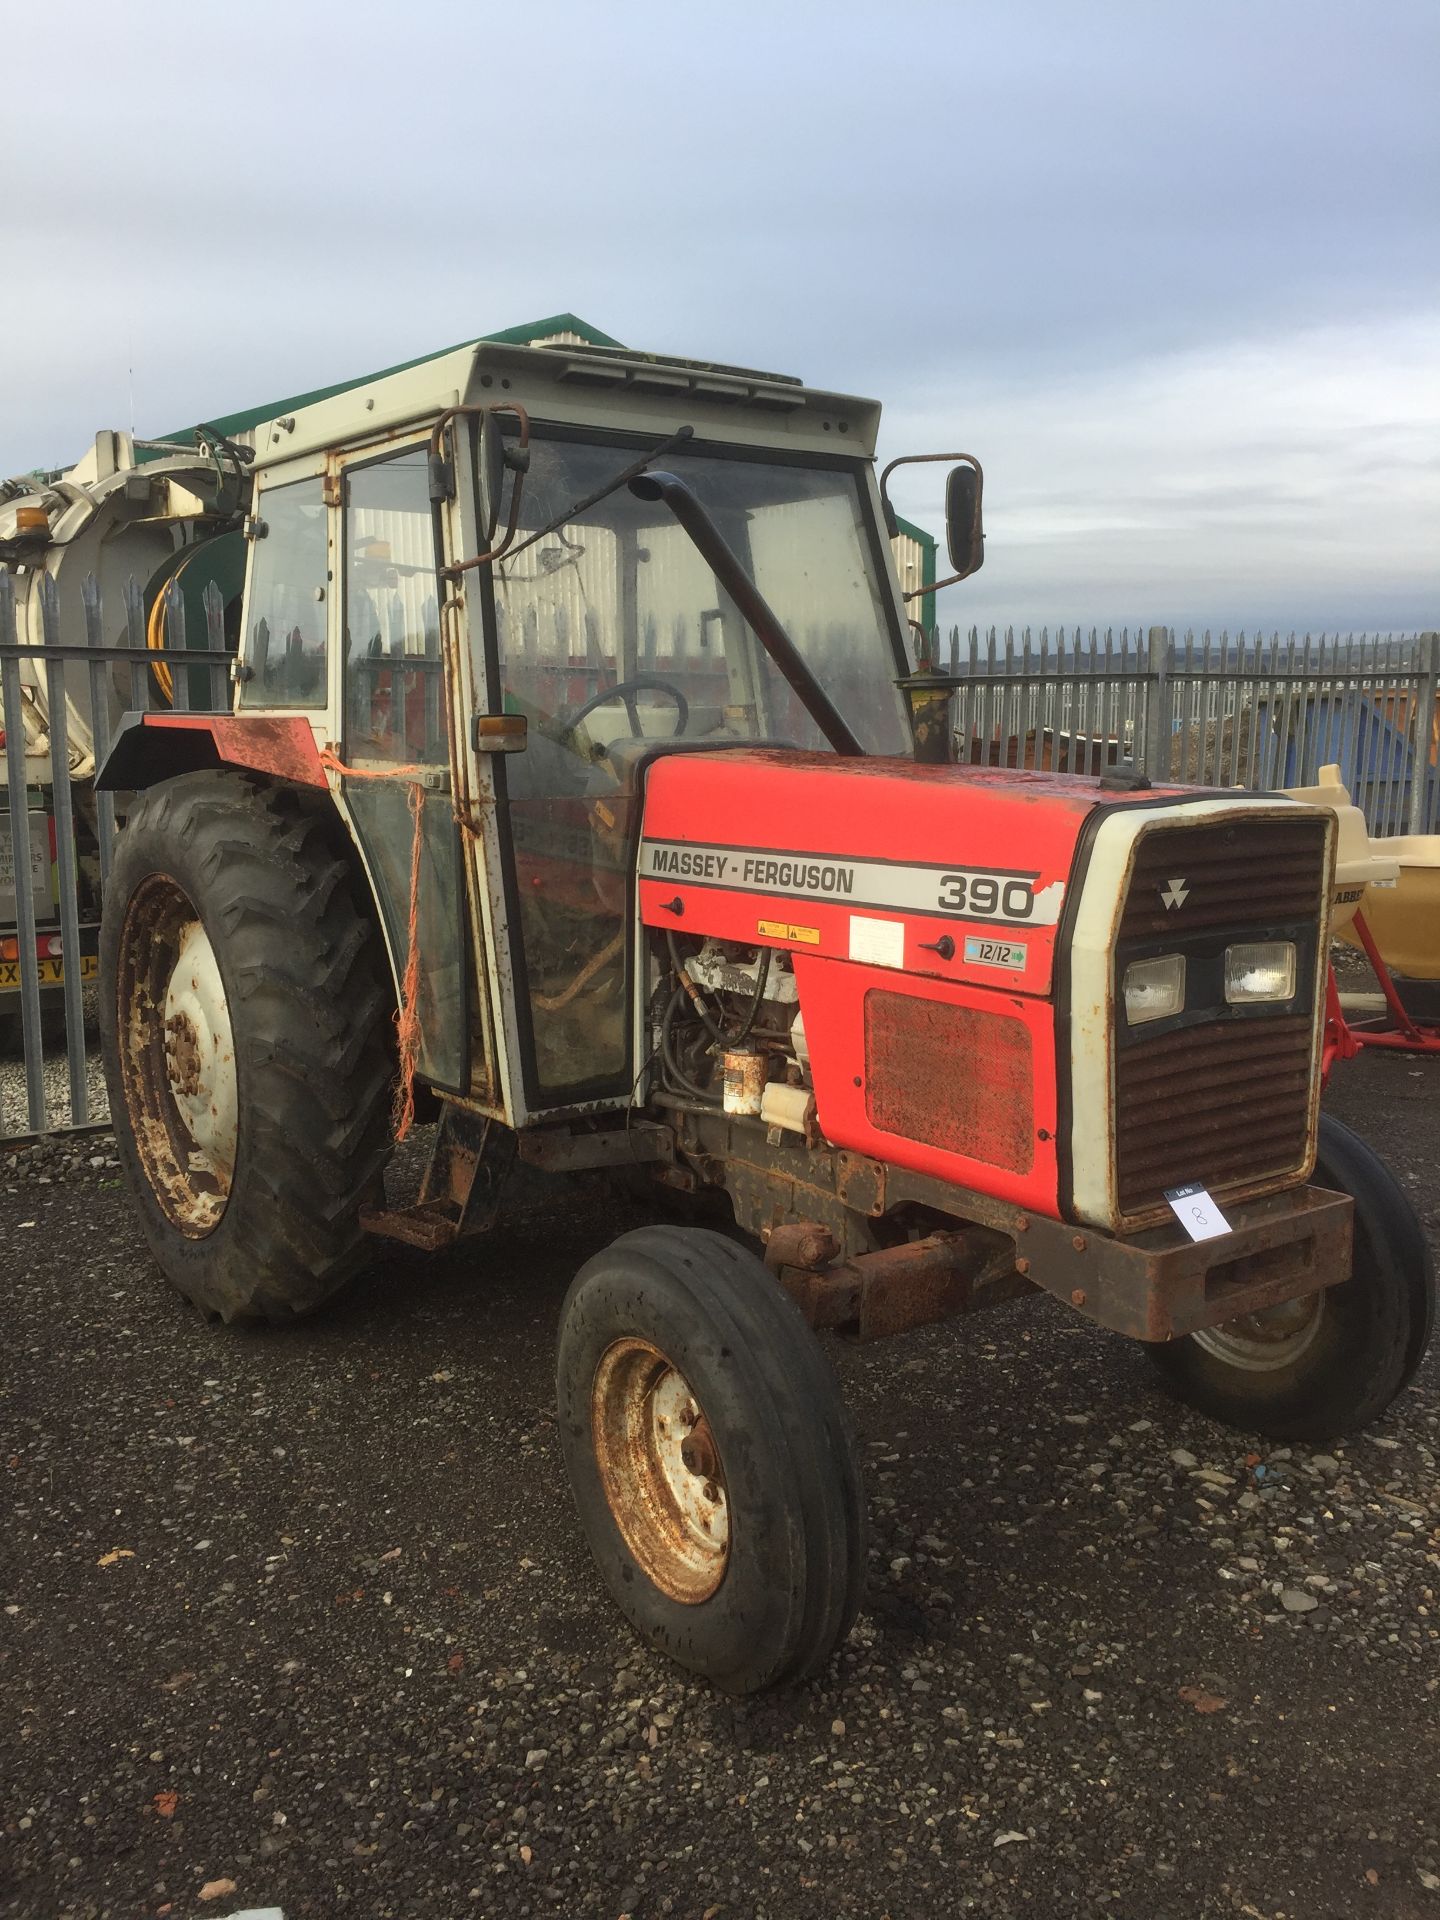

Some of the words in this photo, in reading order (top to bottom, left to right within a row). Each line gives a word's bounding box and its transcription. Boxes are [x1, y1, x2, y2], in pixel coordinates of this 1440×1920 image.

[938, 874, 1035, 918] 390
[1334, 888, 1364, 905] ABBE
[979, 943, 1011, 963] 12/12
[1192, 1207, 1208, 1225] 8
